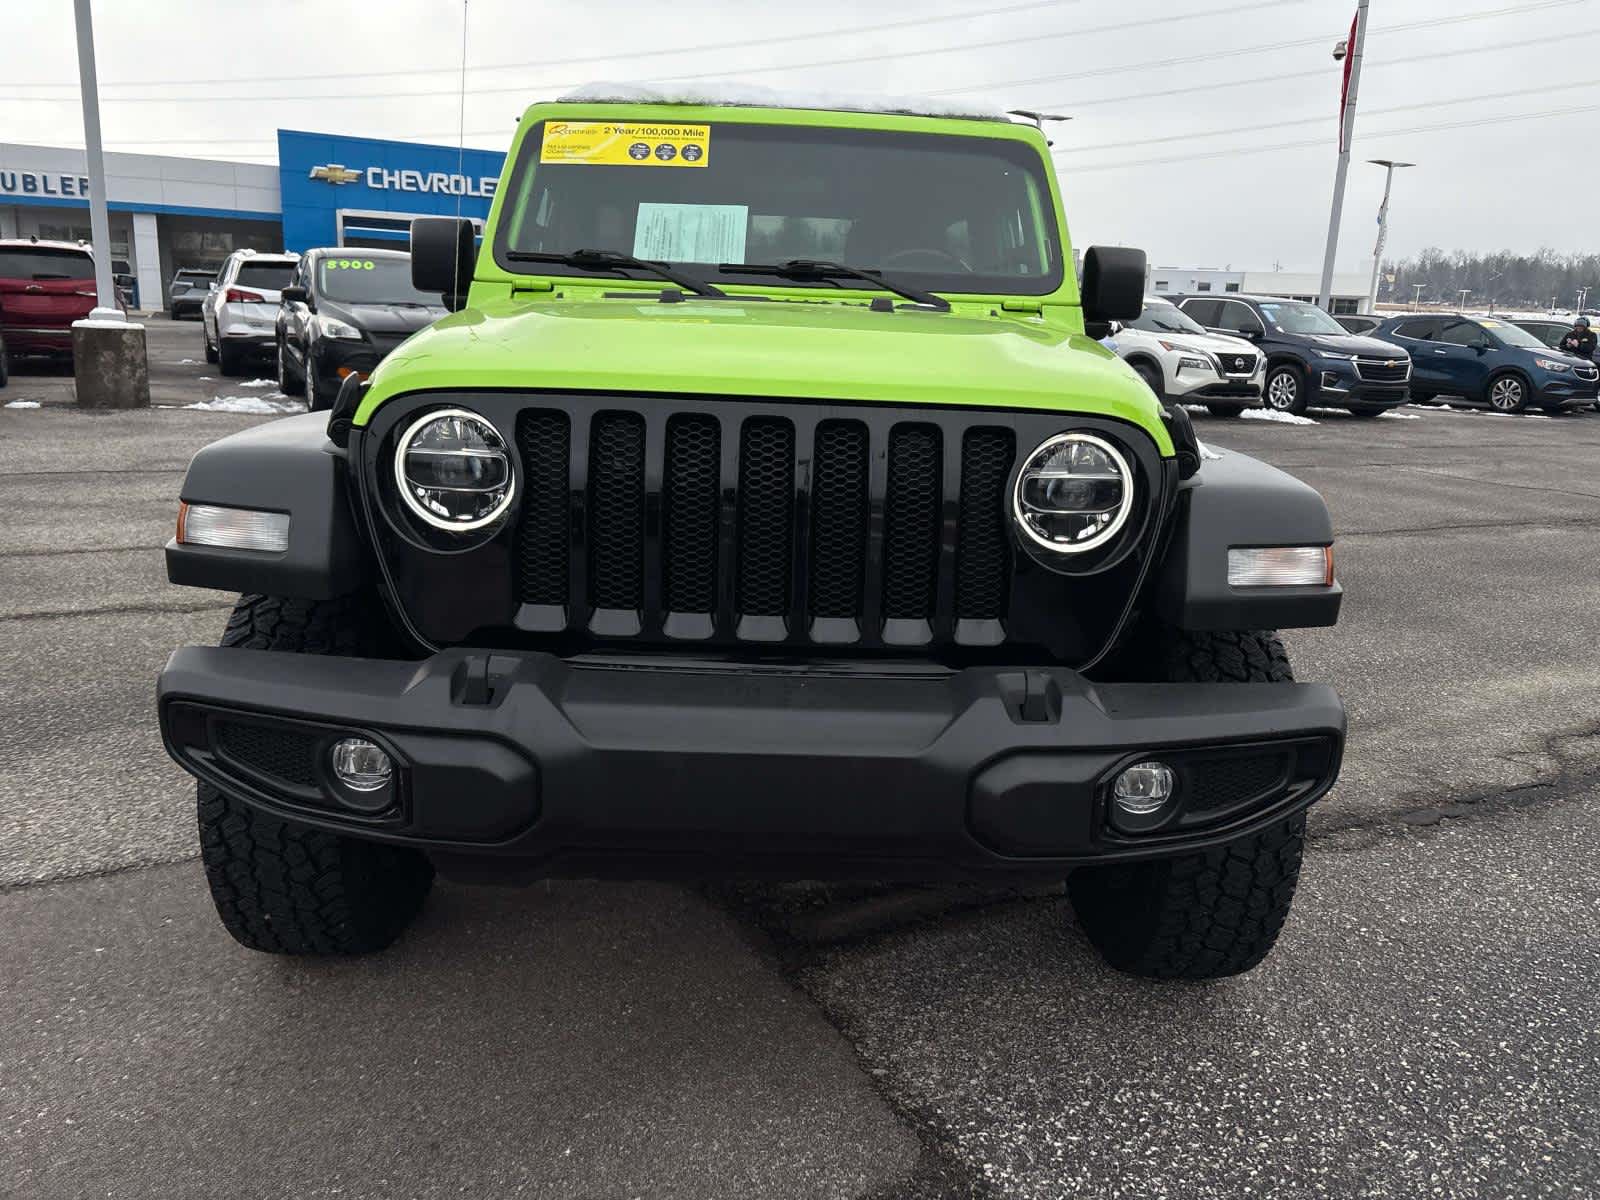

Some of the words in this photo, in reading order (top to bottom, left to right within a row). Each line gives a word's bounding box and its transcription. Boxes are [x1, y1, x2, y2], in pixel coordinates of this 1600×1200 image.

[603, 127, 611, 135] 2
[613, 127, 680, 136] Year/100,000
[682, 128, 705, 137] Mile
